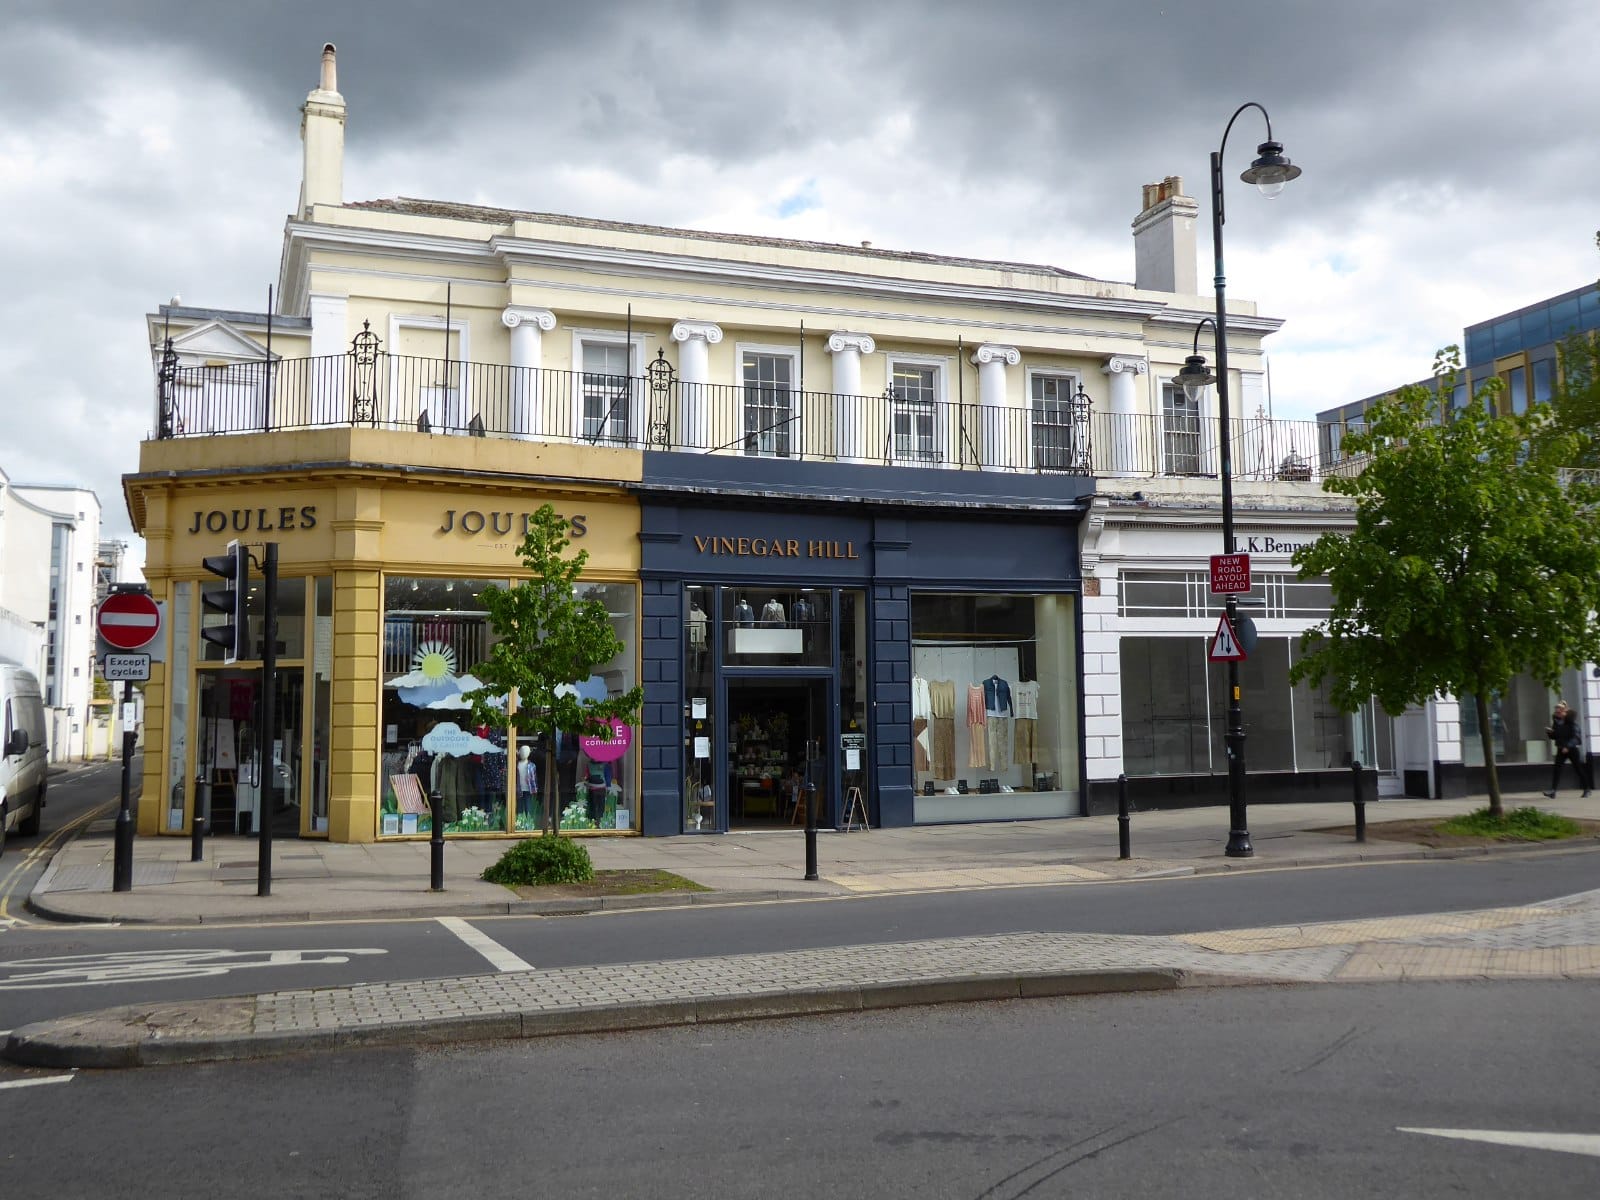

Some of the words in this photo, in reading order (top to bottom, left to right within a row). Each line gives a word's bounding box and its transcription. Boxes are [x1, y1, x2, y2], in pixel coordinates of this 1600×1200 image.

[188, 506, 317, 534] JOULES
[440, 510, 588, 538] JOULS
[693, 535, 800, 557] VINEGAR
[808, 540, 859, 559] HILL
[1233, 536, 1315, 553] L.K.Bennet
[1219, 557, 1240, 565] NEW
[1217, 565, 1243, 574] ROAD
[1214, 573, 1248, 582] LAYOUT
[1215, 582, 1246, 590] AHEAD
[110, 657, 146, 667] Except
[111, 668, 144, 676] cycles
